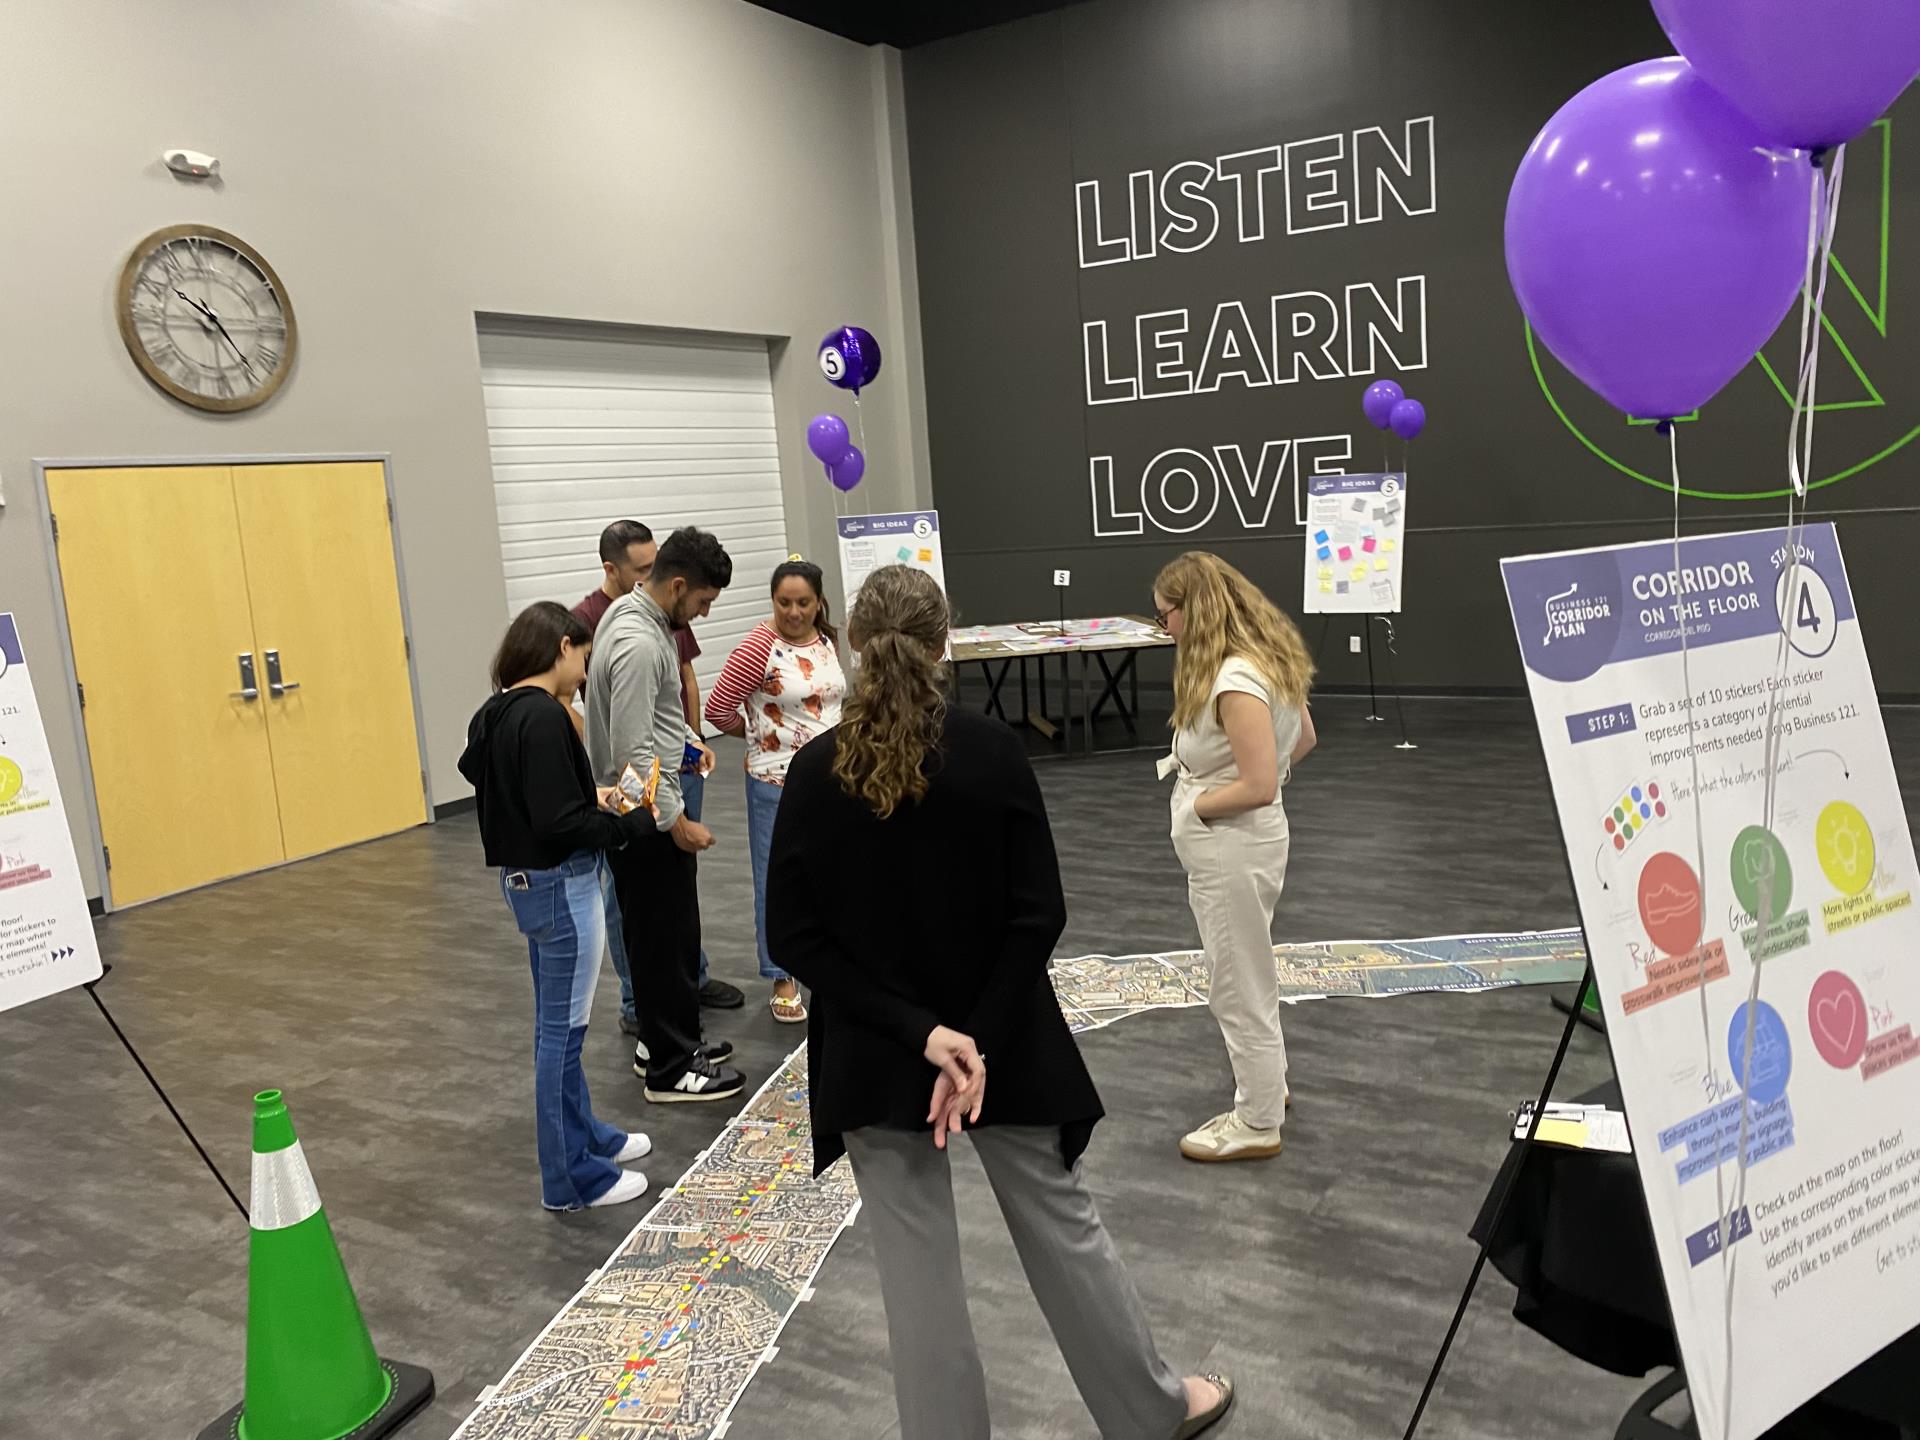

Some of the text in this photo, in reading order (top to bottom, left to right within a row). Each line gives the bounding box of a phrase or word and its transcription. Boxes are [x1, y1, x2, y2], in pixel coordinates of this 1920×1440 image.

[1075, 115, 1437, 269] LISTEN
[1083, 274, 1428, 406] LEARN
[824, 351, 839, 376] 5
[1089, 434, 1352, 537] LOVE
[1385, 481, 1394, 493] 5
[872, 521, 886, 529] BIG
[886, 520, 908, 529] IDEAS
[919, 522, 927, 535] 5
[1770, 544, 1815, 570] STAION
[1058, 572, 1065, 584] 5
[1632, 560, 1755, 601] CORRIDOR
[1549, 597, 1591, 612] BUSINESS
[1551, 604, 1611, 625] CORRIDOR
[1639, 591, 1760, 628] ON THE FLOOR
[1797, 581, 1821, 634] 4
[1554, 621, 1586, 639] PLAN
[1639, 669, 1824, 720] Grab a set of 10 stickers! Each sticker
[1587, 711, 1629, 733] STEP 1:
[1645, 719, 1700, 744] represents
[1703, 717, 1710, 729] a
[1711, 707, 1755, 727] category
[1757, 702, 1767, 717] of
[1726, 726, 1763, 747] needed
[1793, 711, 1837, 731] Business
[1838, 703, 1860, 721] 121.
[1822, 903, 1843, 917] More
[6, 940, 25, 949] map
[27, 929, 53, 943] where
[13, 920, 46, 935] stickers
[6, 941, 47, 960] elements!
[1386, 985, 1440, 993] CORRIDOR
[1662, 1121, 1699, 1147] Enhance
[1755, 1128, 1904, 1222] Check out the map on the floor!
[1760, 1224, 1781, 1246] Use
[1781, 1214, 1799, 1233] the
[1800, 1175, 1870, 1224] corresponding
[1870, 1163, 1893, 1183] color
[1765, 1237, 1804, 1270] identify
[1806, 1222, 1833, 1247] areas
[1834, 1214, 1847, 1231] on
[1848, 1204, 1865, 1221] the
[1865, 1191, 1887, 1213] floor
[1889, 1180, 1910, 1200] map
[1771, 1264, 1799, 1300] you'd
[1800, 1257, 1818, 1277] like
[1819, 1250, 1831, 1266] to
[1832, 1239, 1849, 1260] see
[1850, 1213, 1891, 1248] different
